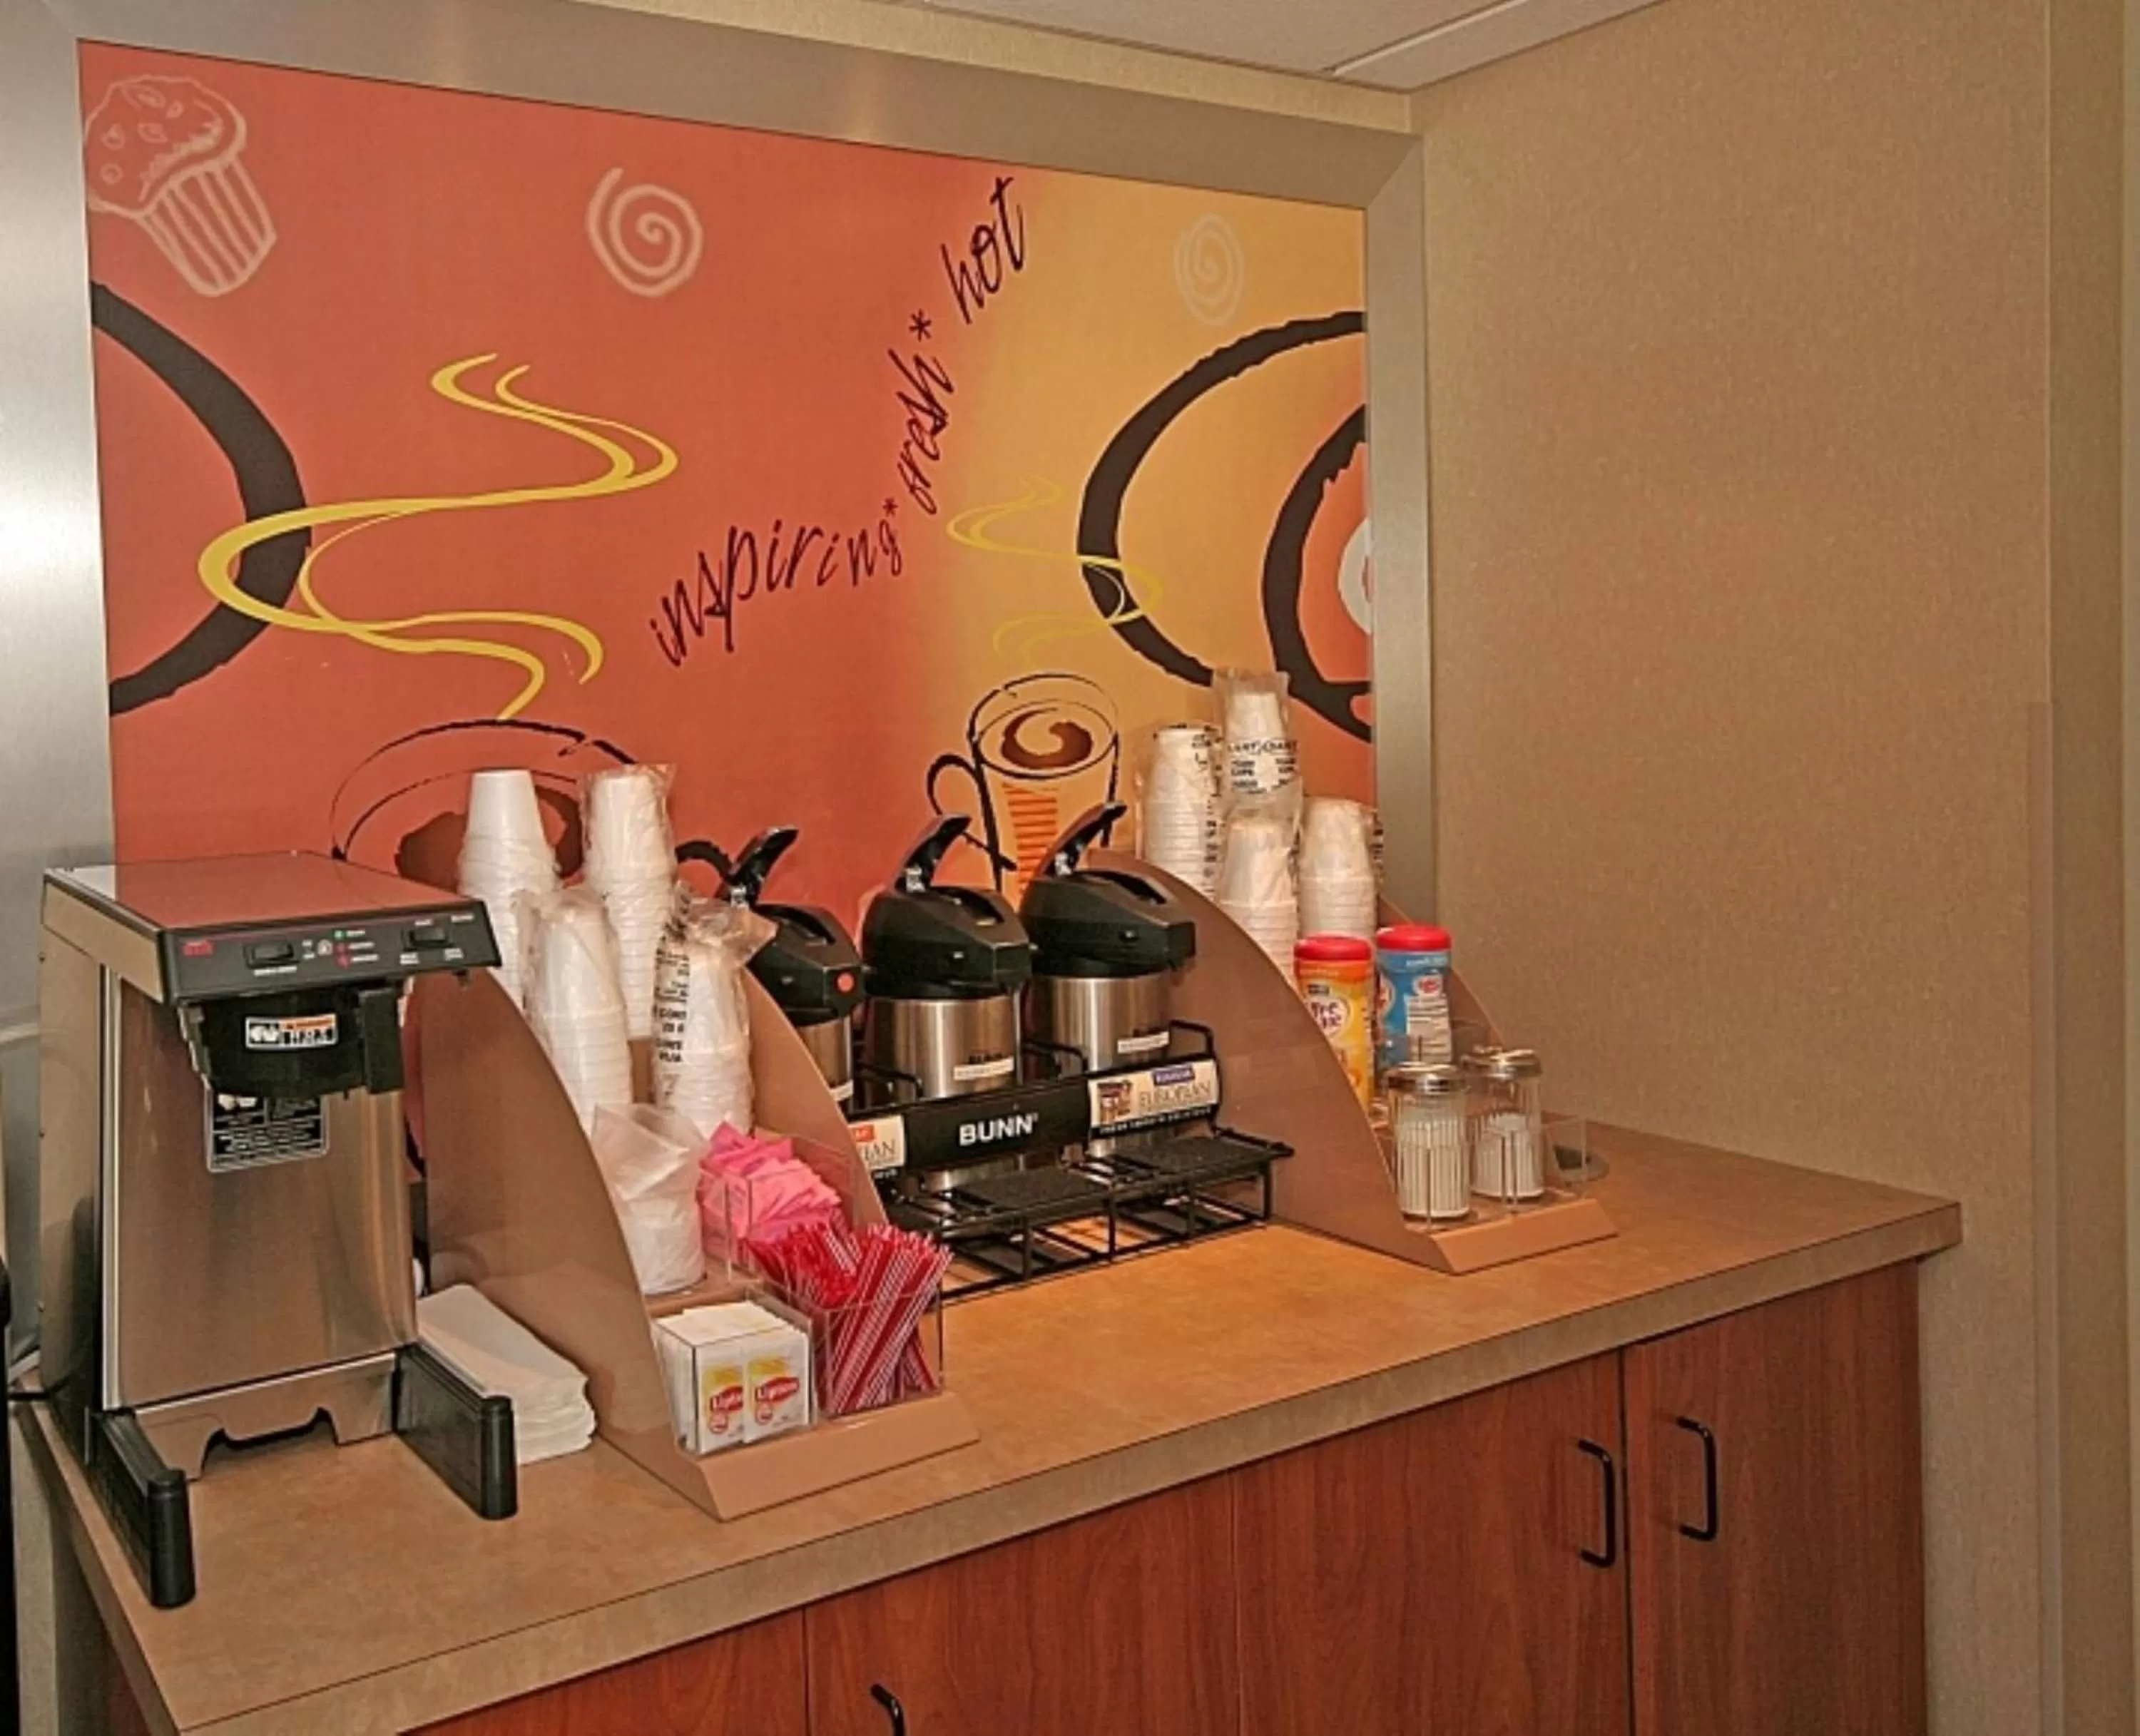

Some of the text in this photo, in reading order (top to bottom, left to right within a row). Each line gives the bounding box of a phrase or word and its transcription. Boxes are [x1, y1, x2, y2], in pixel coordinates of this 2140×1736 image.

[650, 519, 902, 666] inspiring
[940, 176, 1025, 324] hot
[959, 1114, 1033, 1146] BUNN
